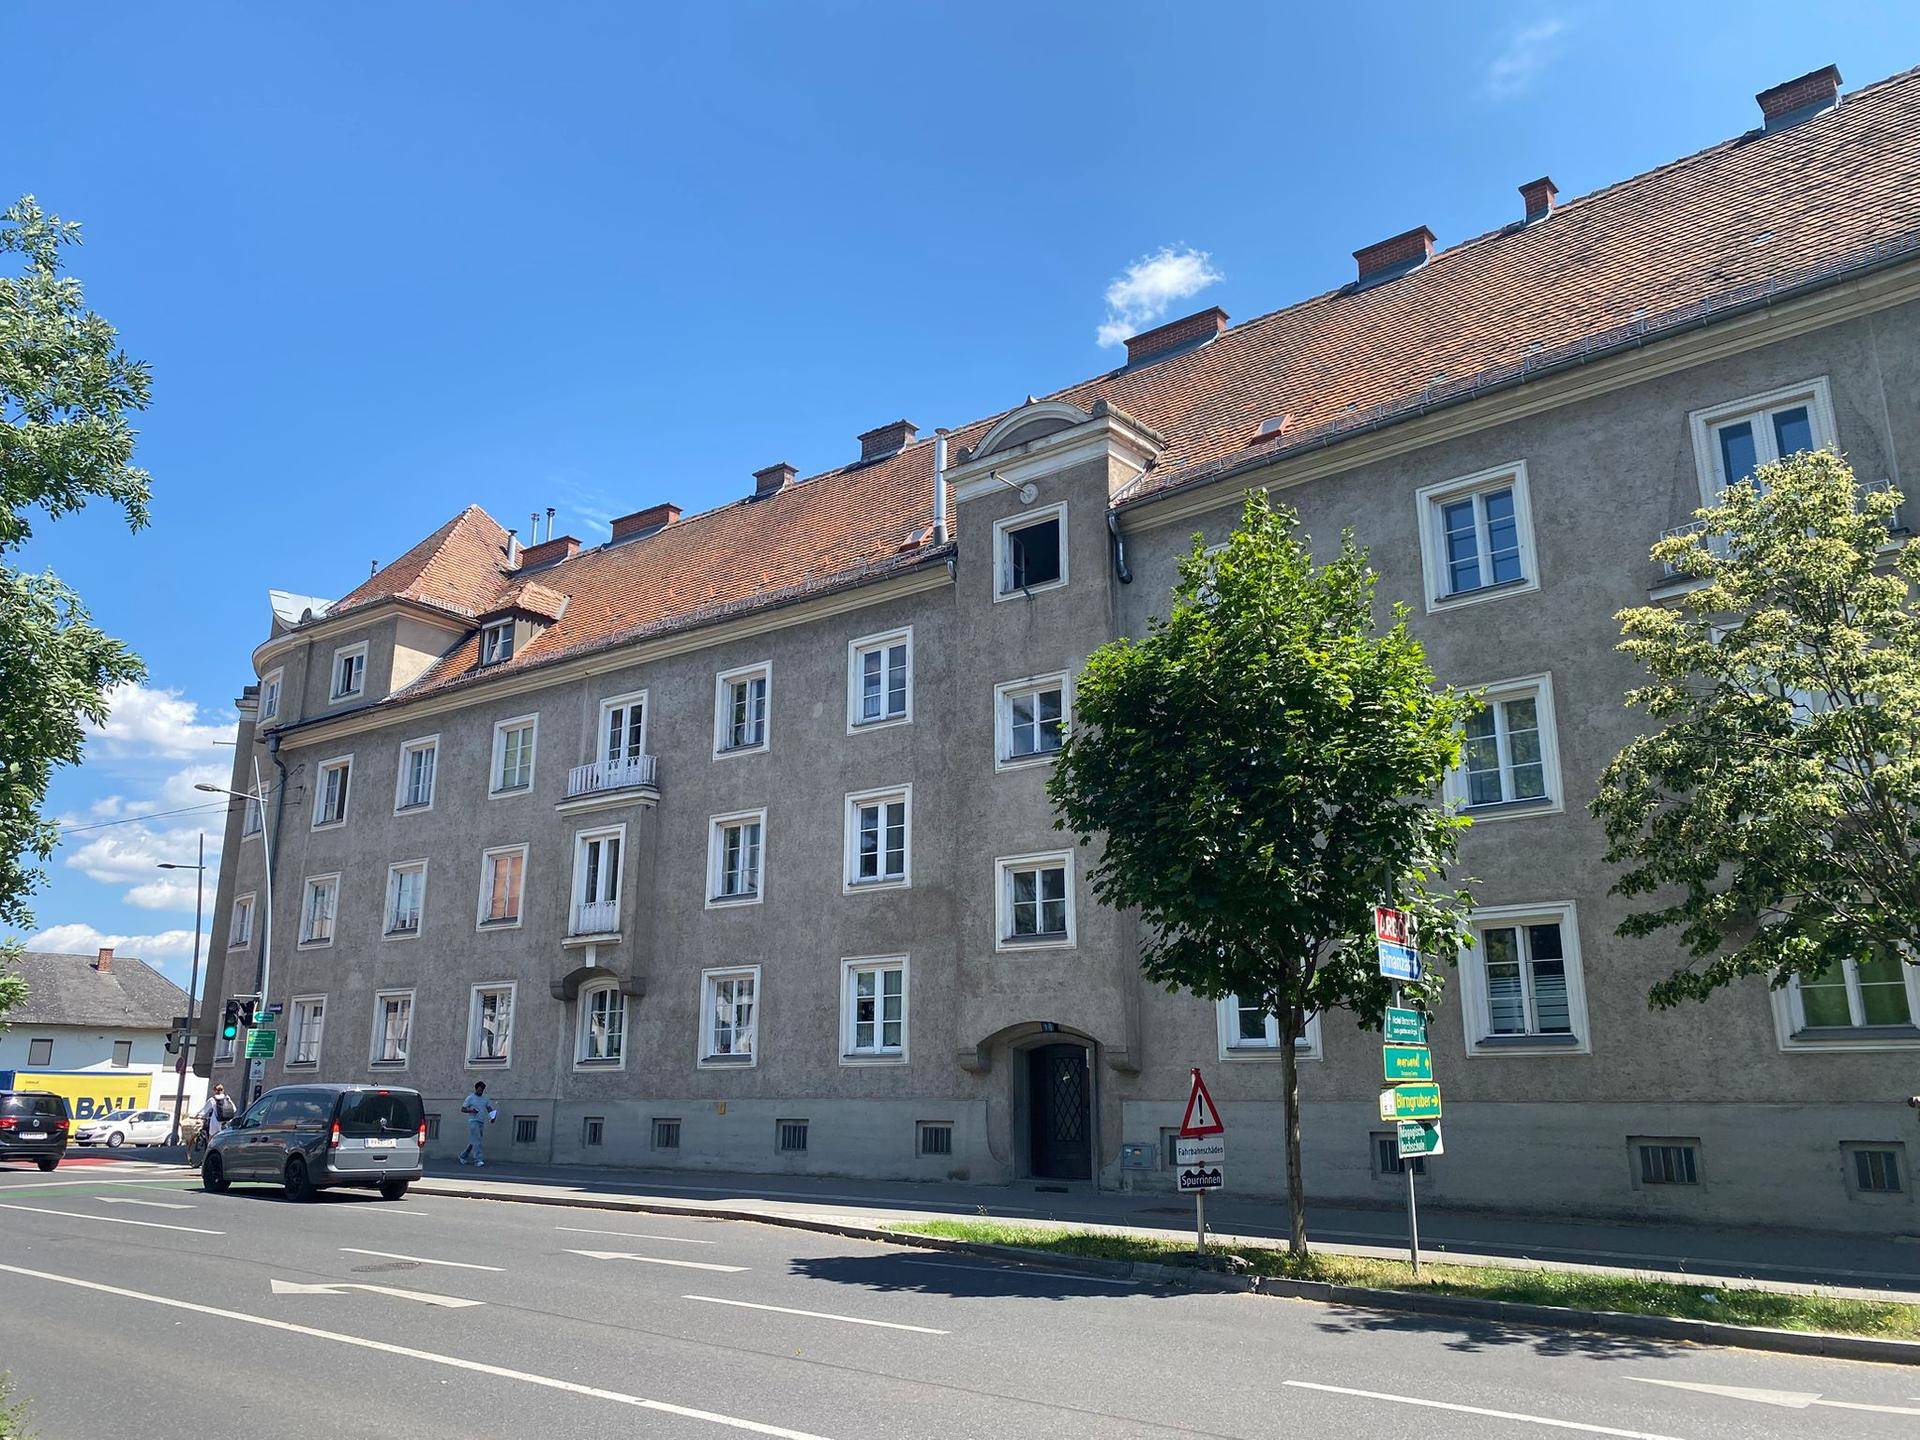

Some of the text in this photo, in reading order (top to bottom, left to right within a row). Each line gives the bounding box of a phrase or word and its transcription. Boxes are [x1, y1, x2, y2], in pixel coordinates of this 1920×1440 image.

[1396, 1093, 1431, 1111] Birngruber
[1178, 1146, 1224, 1156] Fahrbahnschäden
[1181, 1175, 1221, 1187] Spurrinnen
